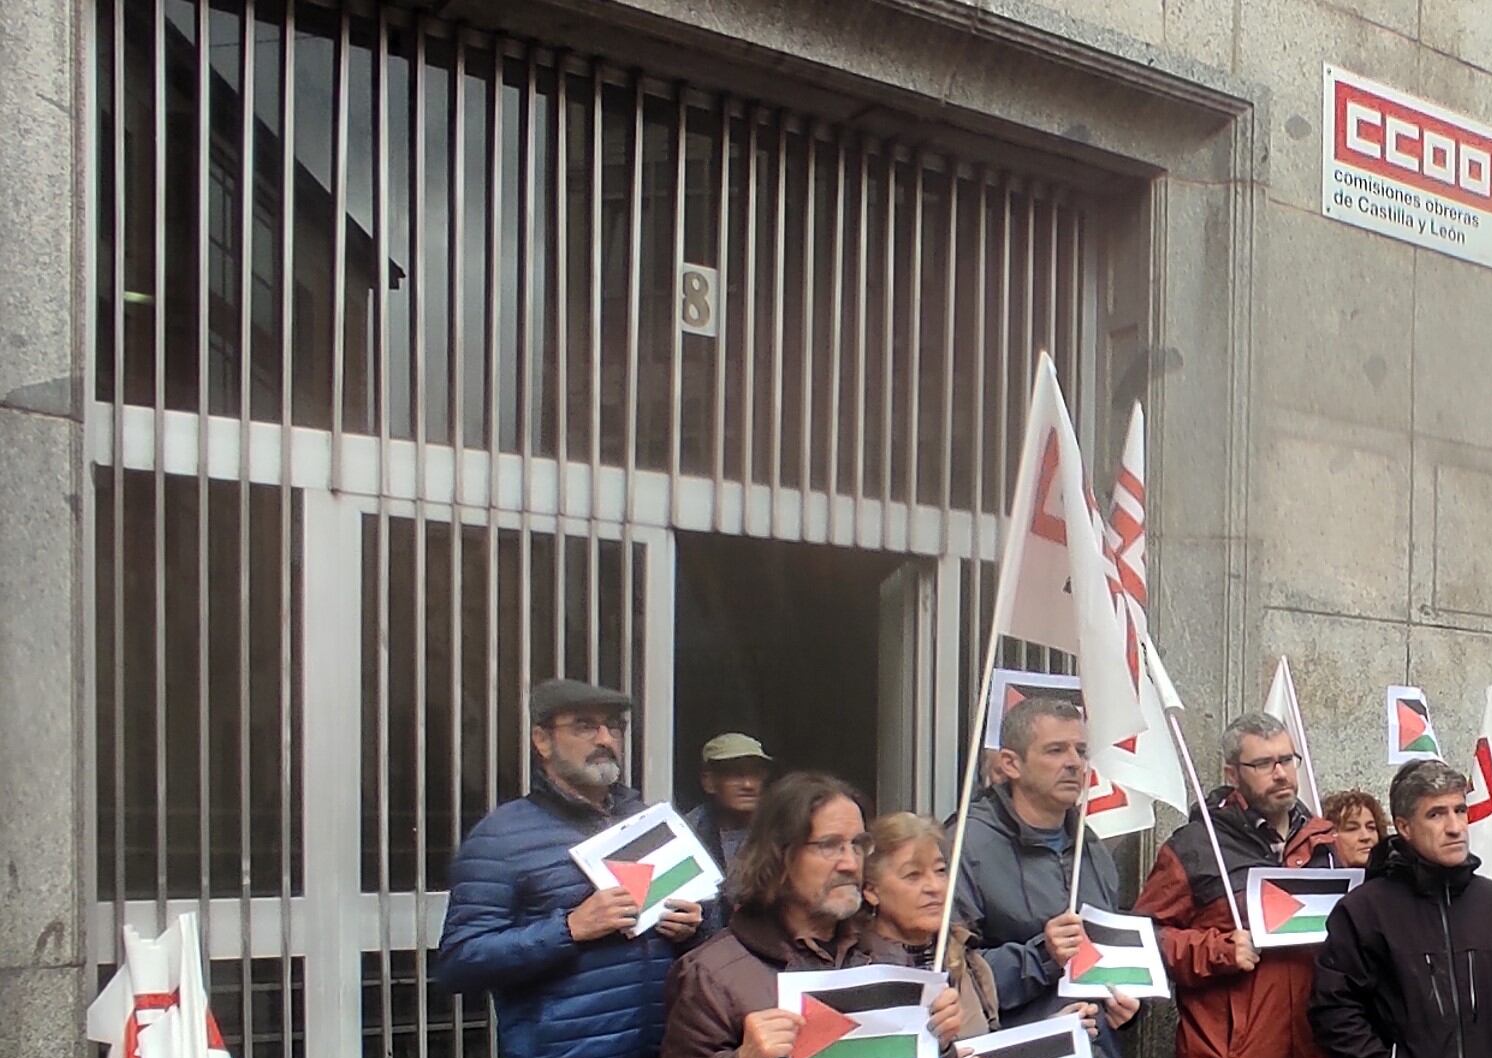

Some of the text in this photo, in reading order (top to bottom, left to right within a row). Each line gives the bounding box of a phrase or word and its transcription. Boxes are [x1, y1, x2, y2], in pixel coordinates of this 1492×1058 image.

[1346, 98, 1491, 197] CCOO
[1334, 169, 1480, 228] comisiones obreras
[1334, 189, 1466, 244] de Castilla y León
[681, 271, 710, 328] 8
